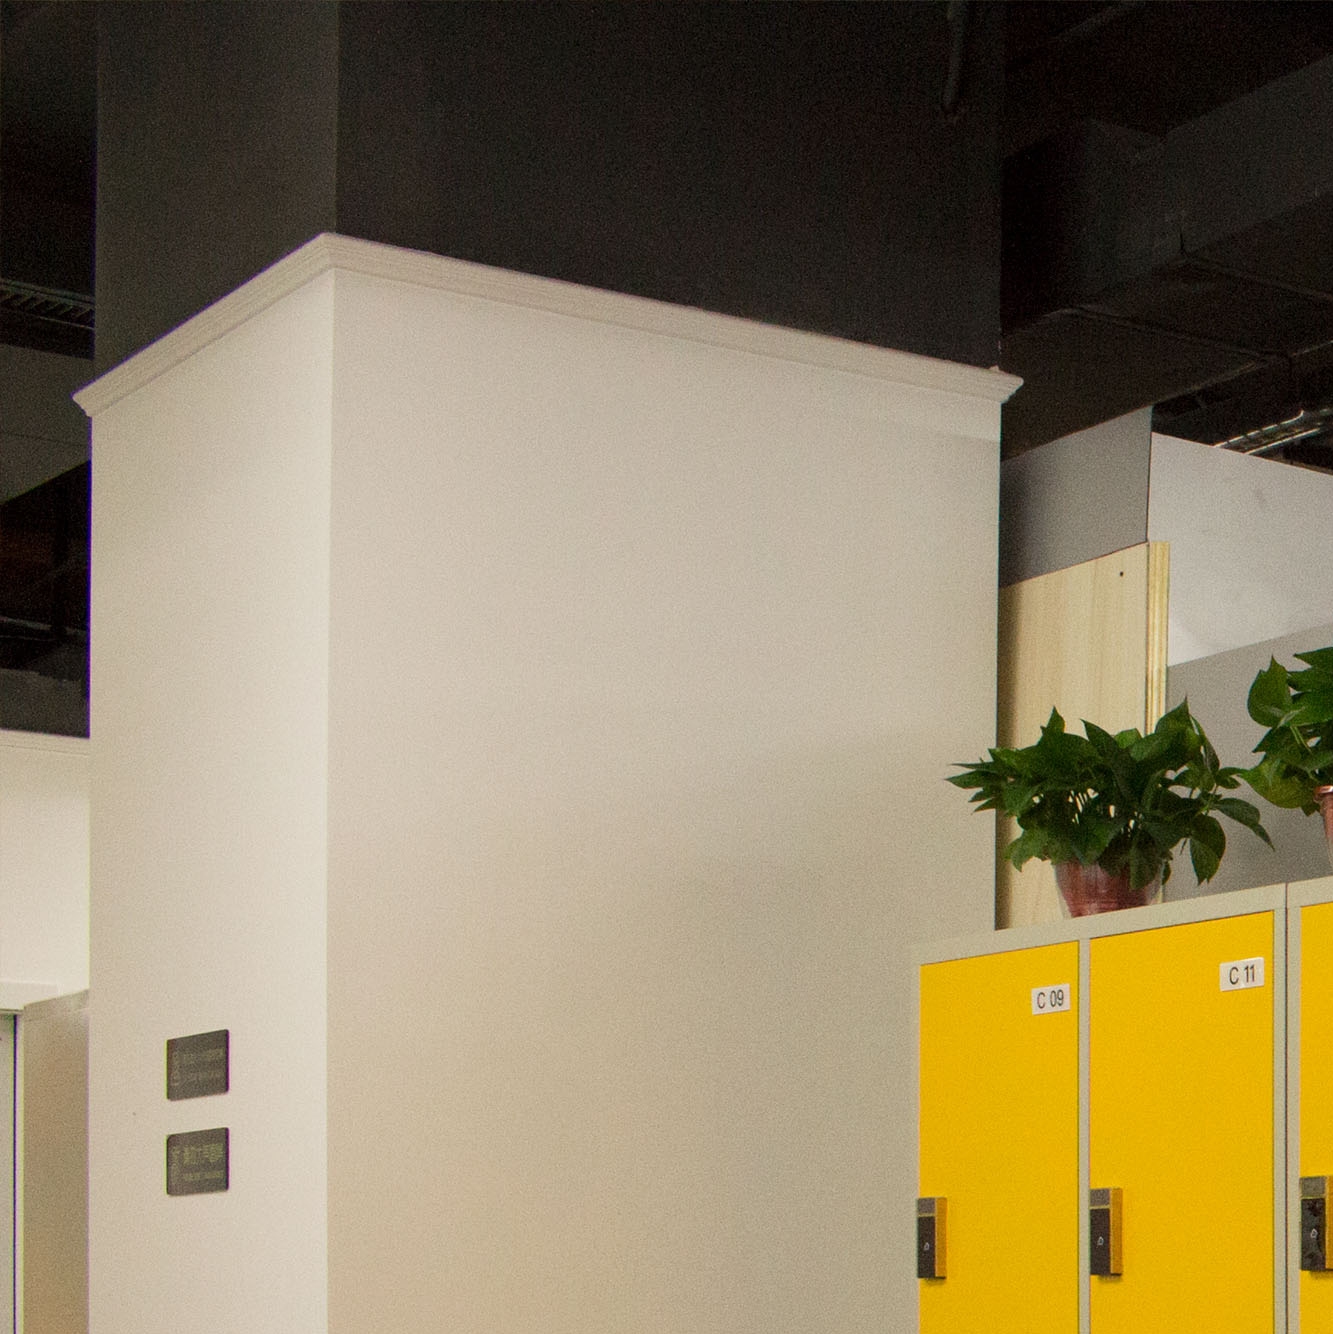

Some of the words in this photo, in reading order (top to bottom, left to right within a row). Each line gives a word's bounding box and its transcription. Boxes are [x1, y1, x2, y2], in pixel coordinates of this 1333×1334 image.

[1229, 966, 1239, 985] C
[1244, 964, 1255, 983] 11
[1037, 991, 1046, 1009] C
[1050, 989, 1064, 1007] 09
